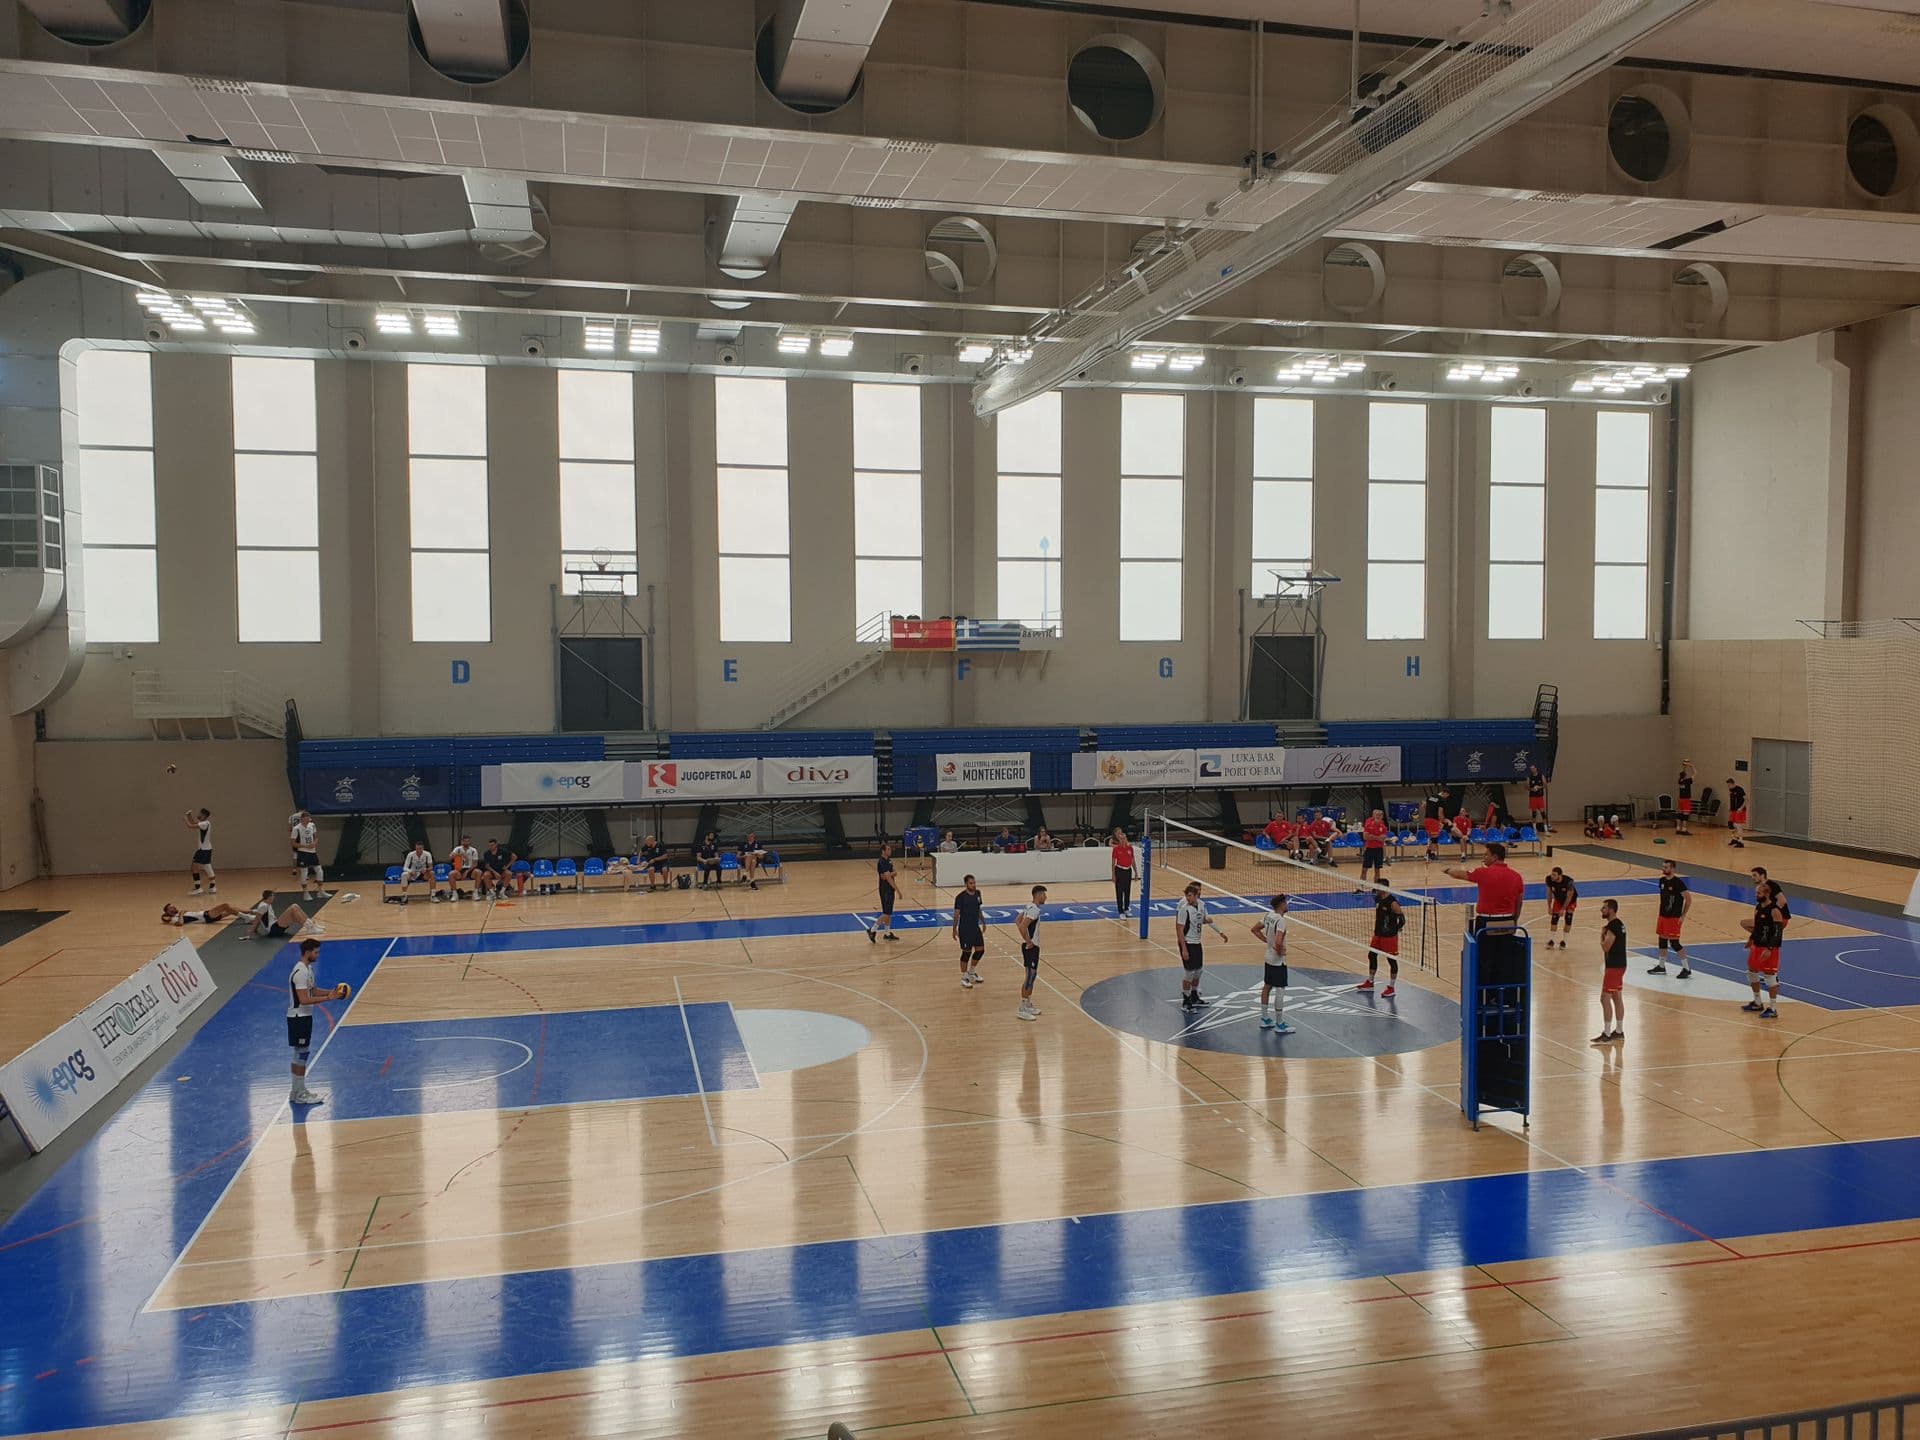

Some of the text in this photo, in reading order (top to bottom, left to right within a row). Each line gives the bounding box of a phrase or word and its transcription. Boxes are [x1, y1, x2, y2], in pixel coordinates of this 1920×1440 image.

[452, 660, 470, 683] D
[723, 659, 737, 682] E
[958, 658, 971, 680] F
[1159, 657, 1173, 678] G
[1406, 656, 1420, 678] H
[1231, 753, 1276, 763] LUKA BAR
[559, 775, 591, 789] epcg
[681, 769, 752, 781] JUGOPETROL AD
[787, 766, 849, 782] diva
[963, 767, 1026, 781] MONTENEGRO
[1224, 767, 1282, 777] PORT OF BAR
[157, 960, 198, 1004] diva
[52, 1048, 95, 1095] epcg
